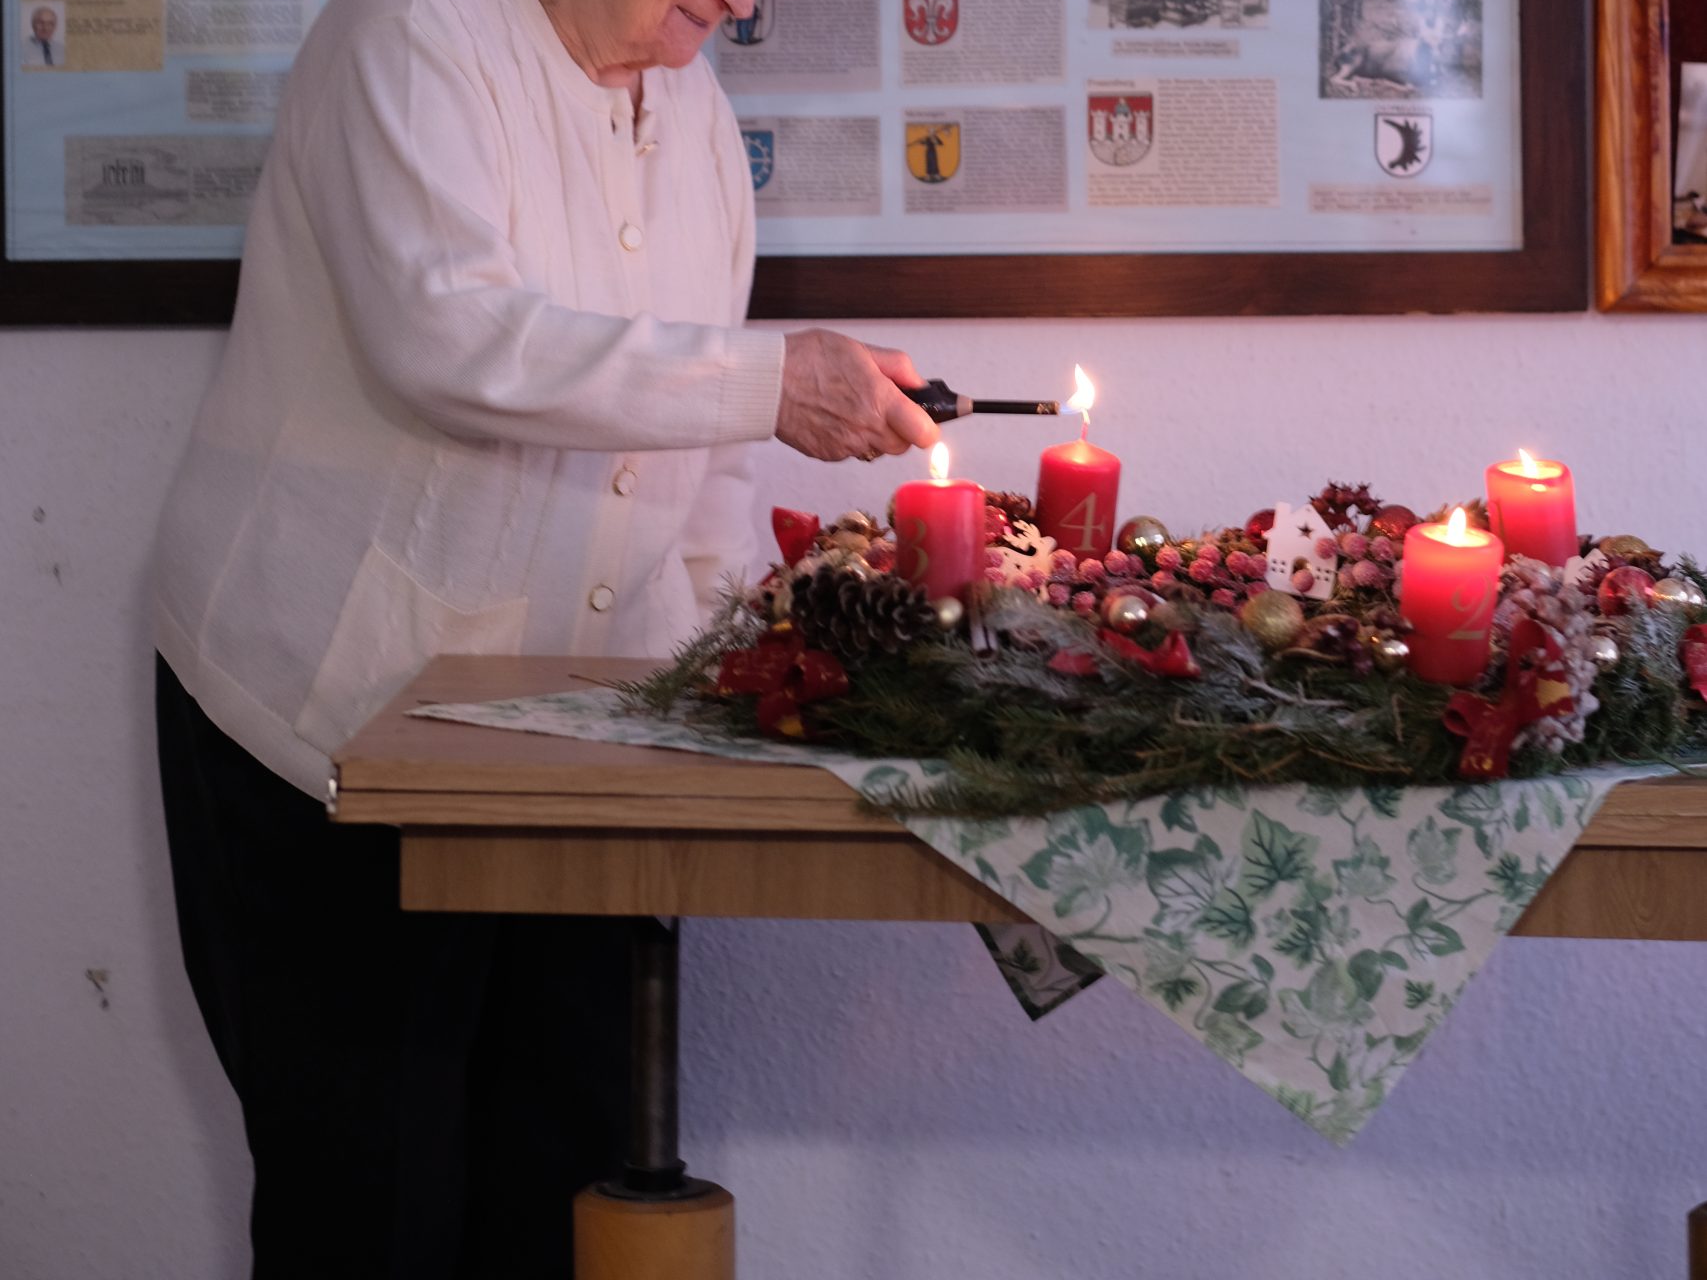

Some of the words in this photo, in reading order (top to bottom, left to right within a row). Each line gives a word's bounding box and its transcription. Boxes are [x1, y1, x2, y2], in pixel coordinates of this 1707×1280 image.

[906, 517, 929, 581] 3
[1058, 492, 1106, 552] 4
[1448, 575, 1493, 640] 2
